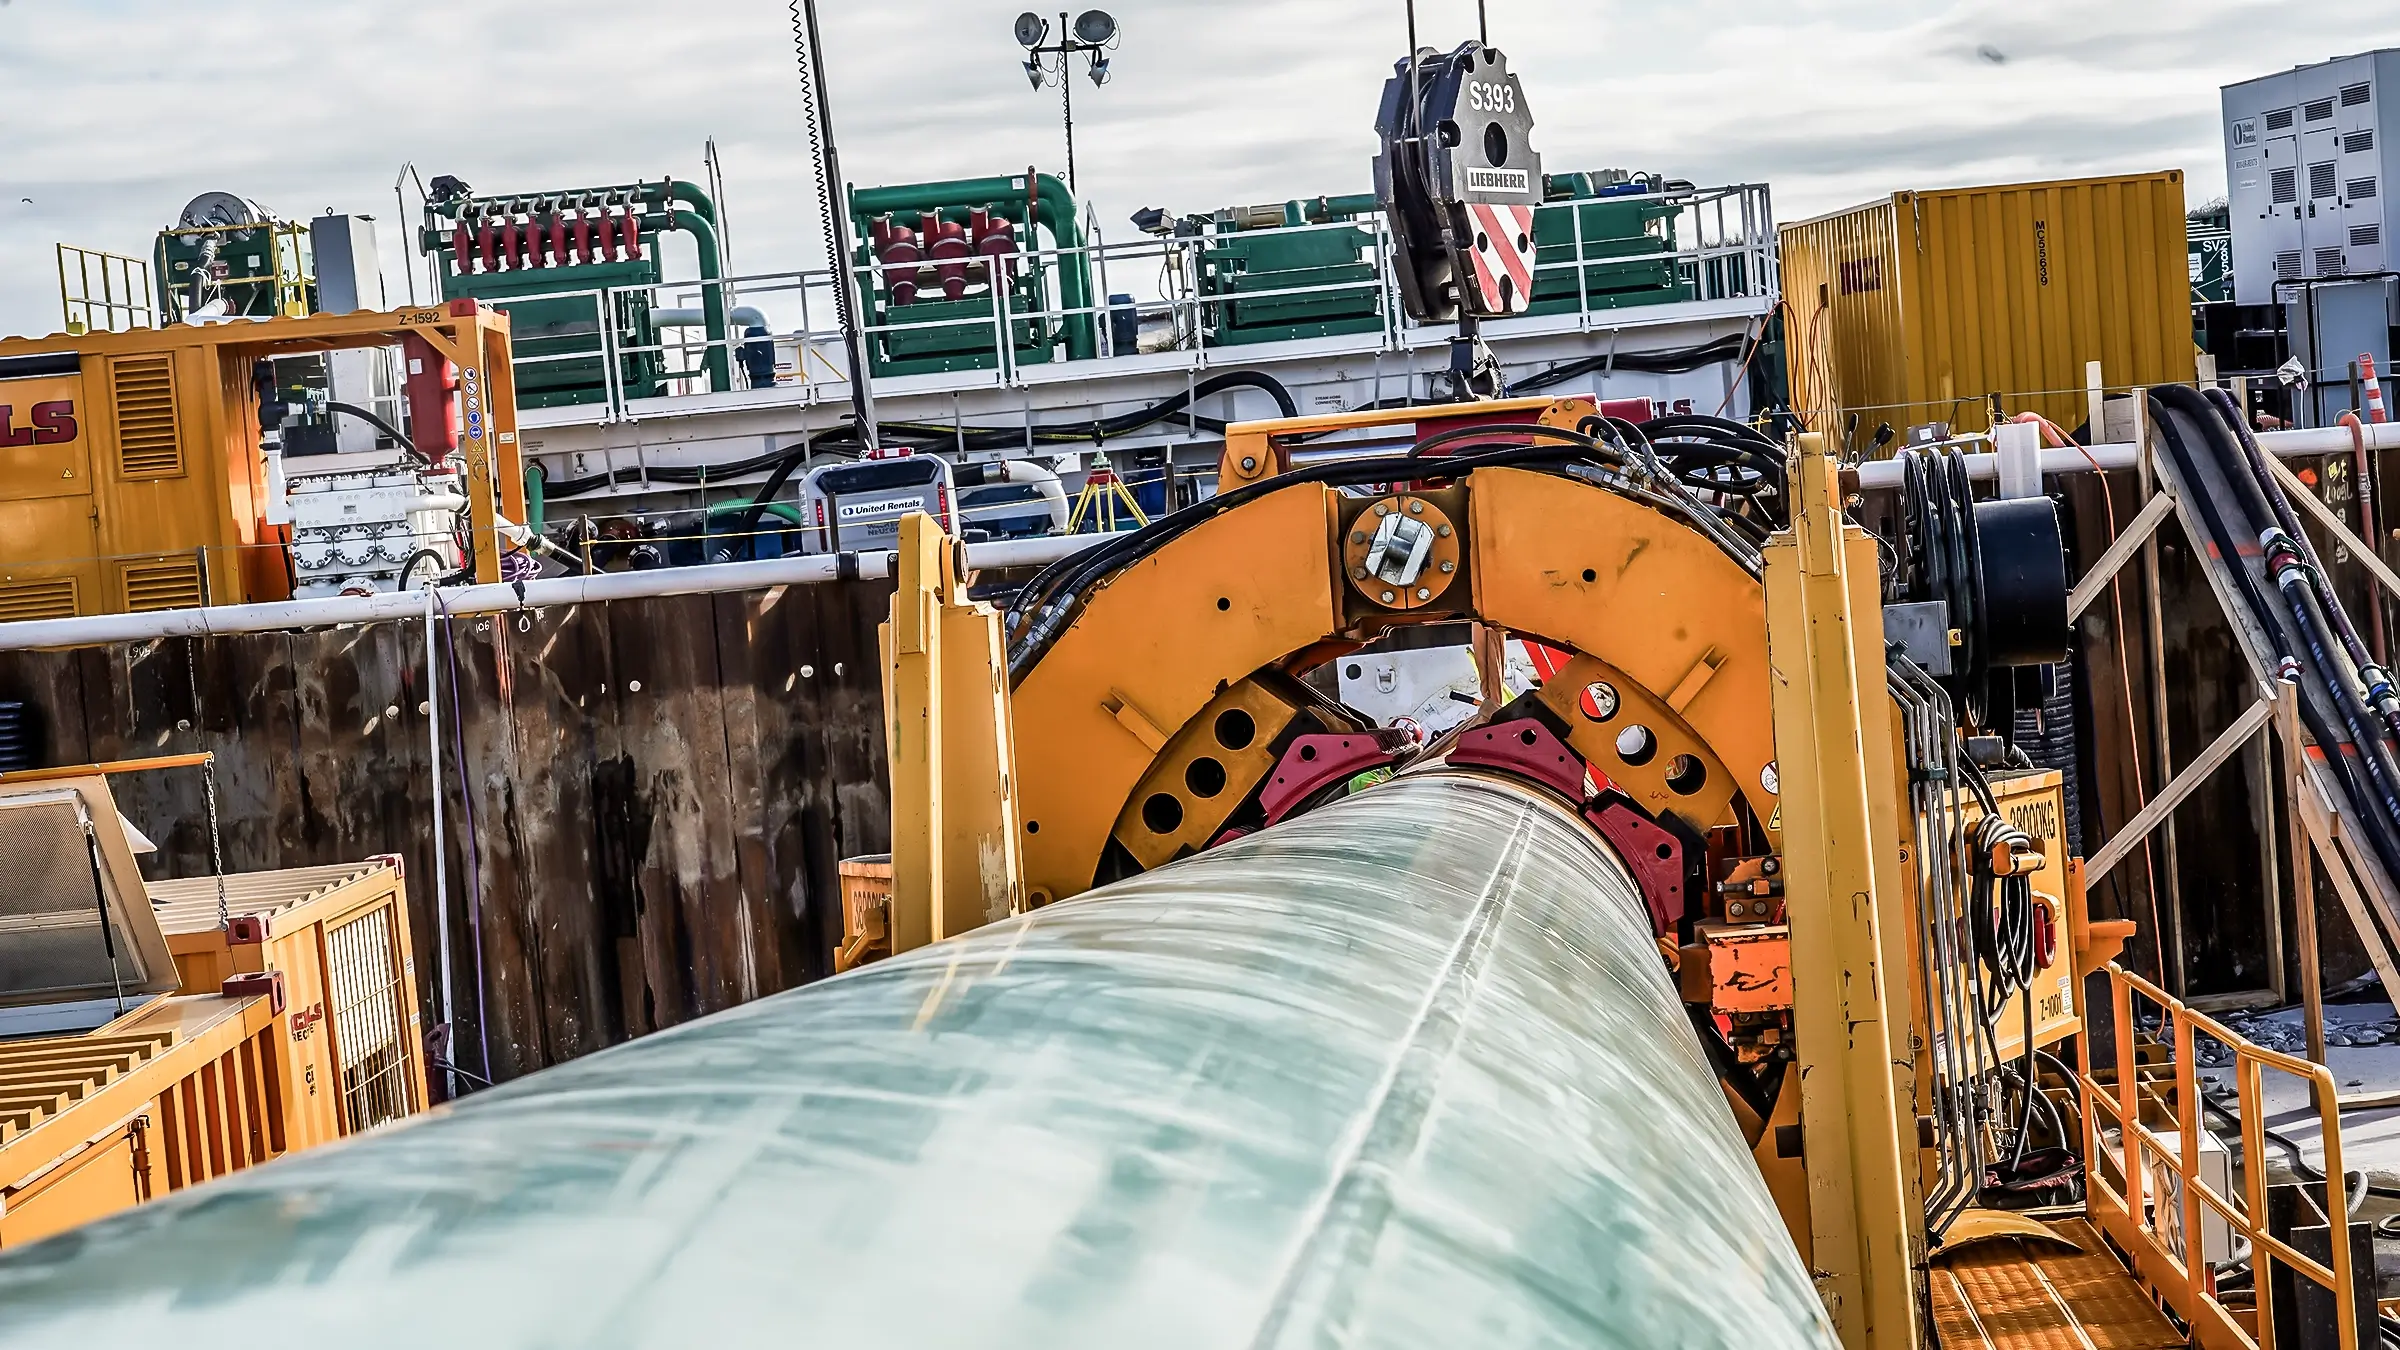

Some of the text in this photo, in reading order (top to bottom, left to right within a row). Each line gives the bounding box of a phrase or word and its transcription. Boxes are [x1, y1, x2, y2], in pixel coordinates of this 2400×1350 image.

[1469, 81, 1515, 114] S393
[1470, 172, 1527, 189] LIEBHERR
[2035, 220, 2048, 286] MC55639
[399, 311, 441, 325] Z-1592
[855, 499, 920, 515] United Rentals
